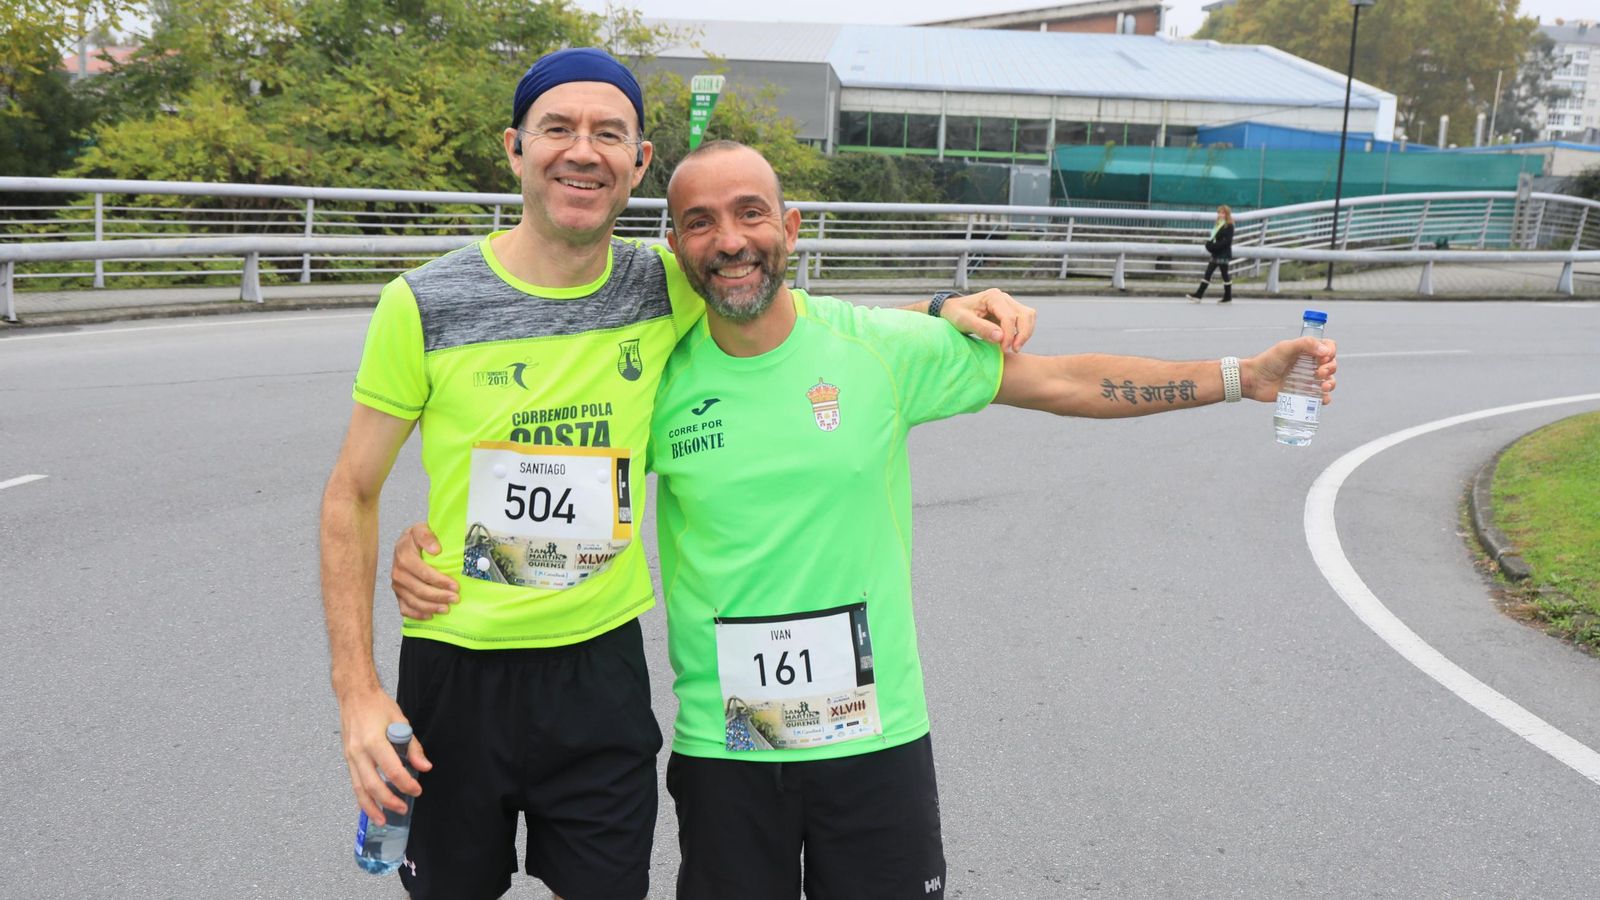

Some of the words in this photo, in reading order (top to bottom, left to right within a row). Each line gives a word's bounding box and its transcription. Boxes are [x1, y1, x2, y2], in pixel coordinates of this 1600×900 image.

[488, 376, 508, 385] 2017
[512, 405, 577, 426] CORRENDO
[581, 402, 613, 417] POLA
[669, 424, 698, 438] CORRE
[702, 419, 722, 431] POR
[671, 433, 724, 459] BEGONTE
[520, 462, 566, 475] SANTIAGO
[505, 483, 576, 524] 504
[528, 561, 565, 569] OURENSE
[771, 629, 791, 641] IVAN
[753, 649, 812, 686] 161
[831, 700, 866, 717] XLVIII
[786, 719, 820, 728] OURENSE
